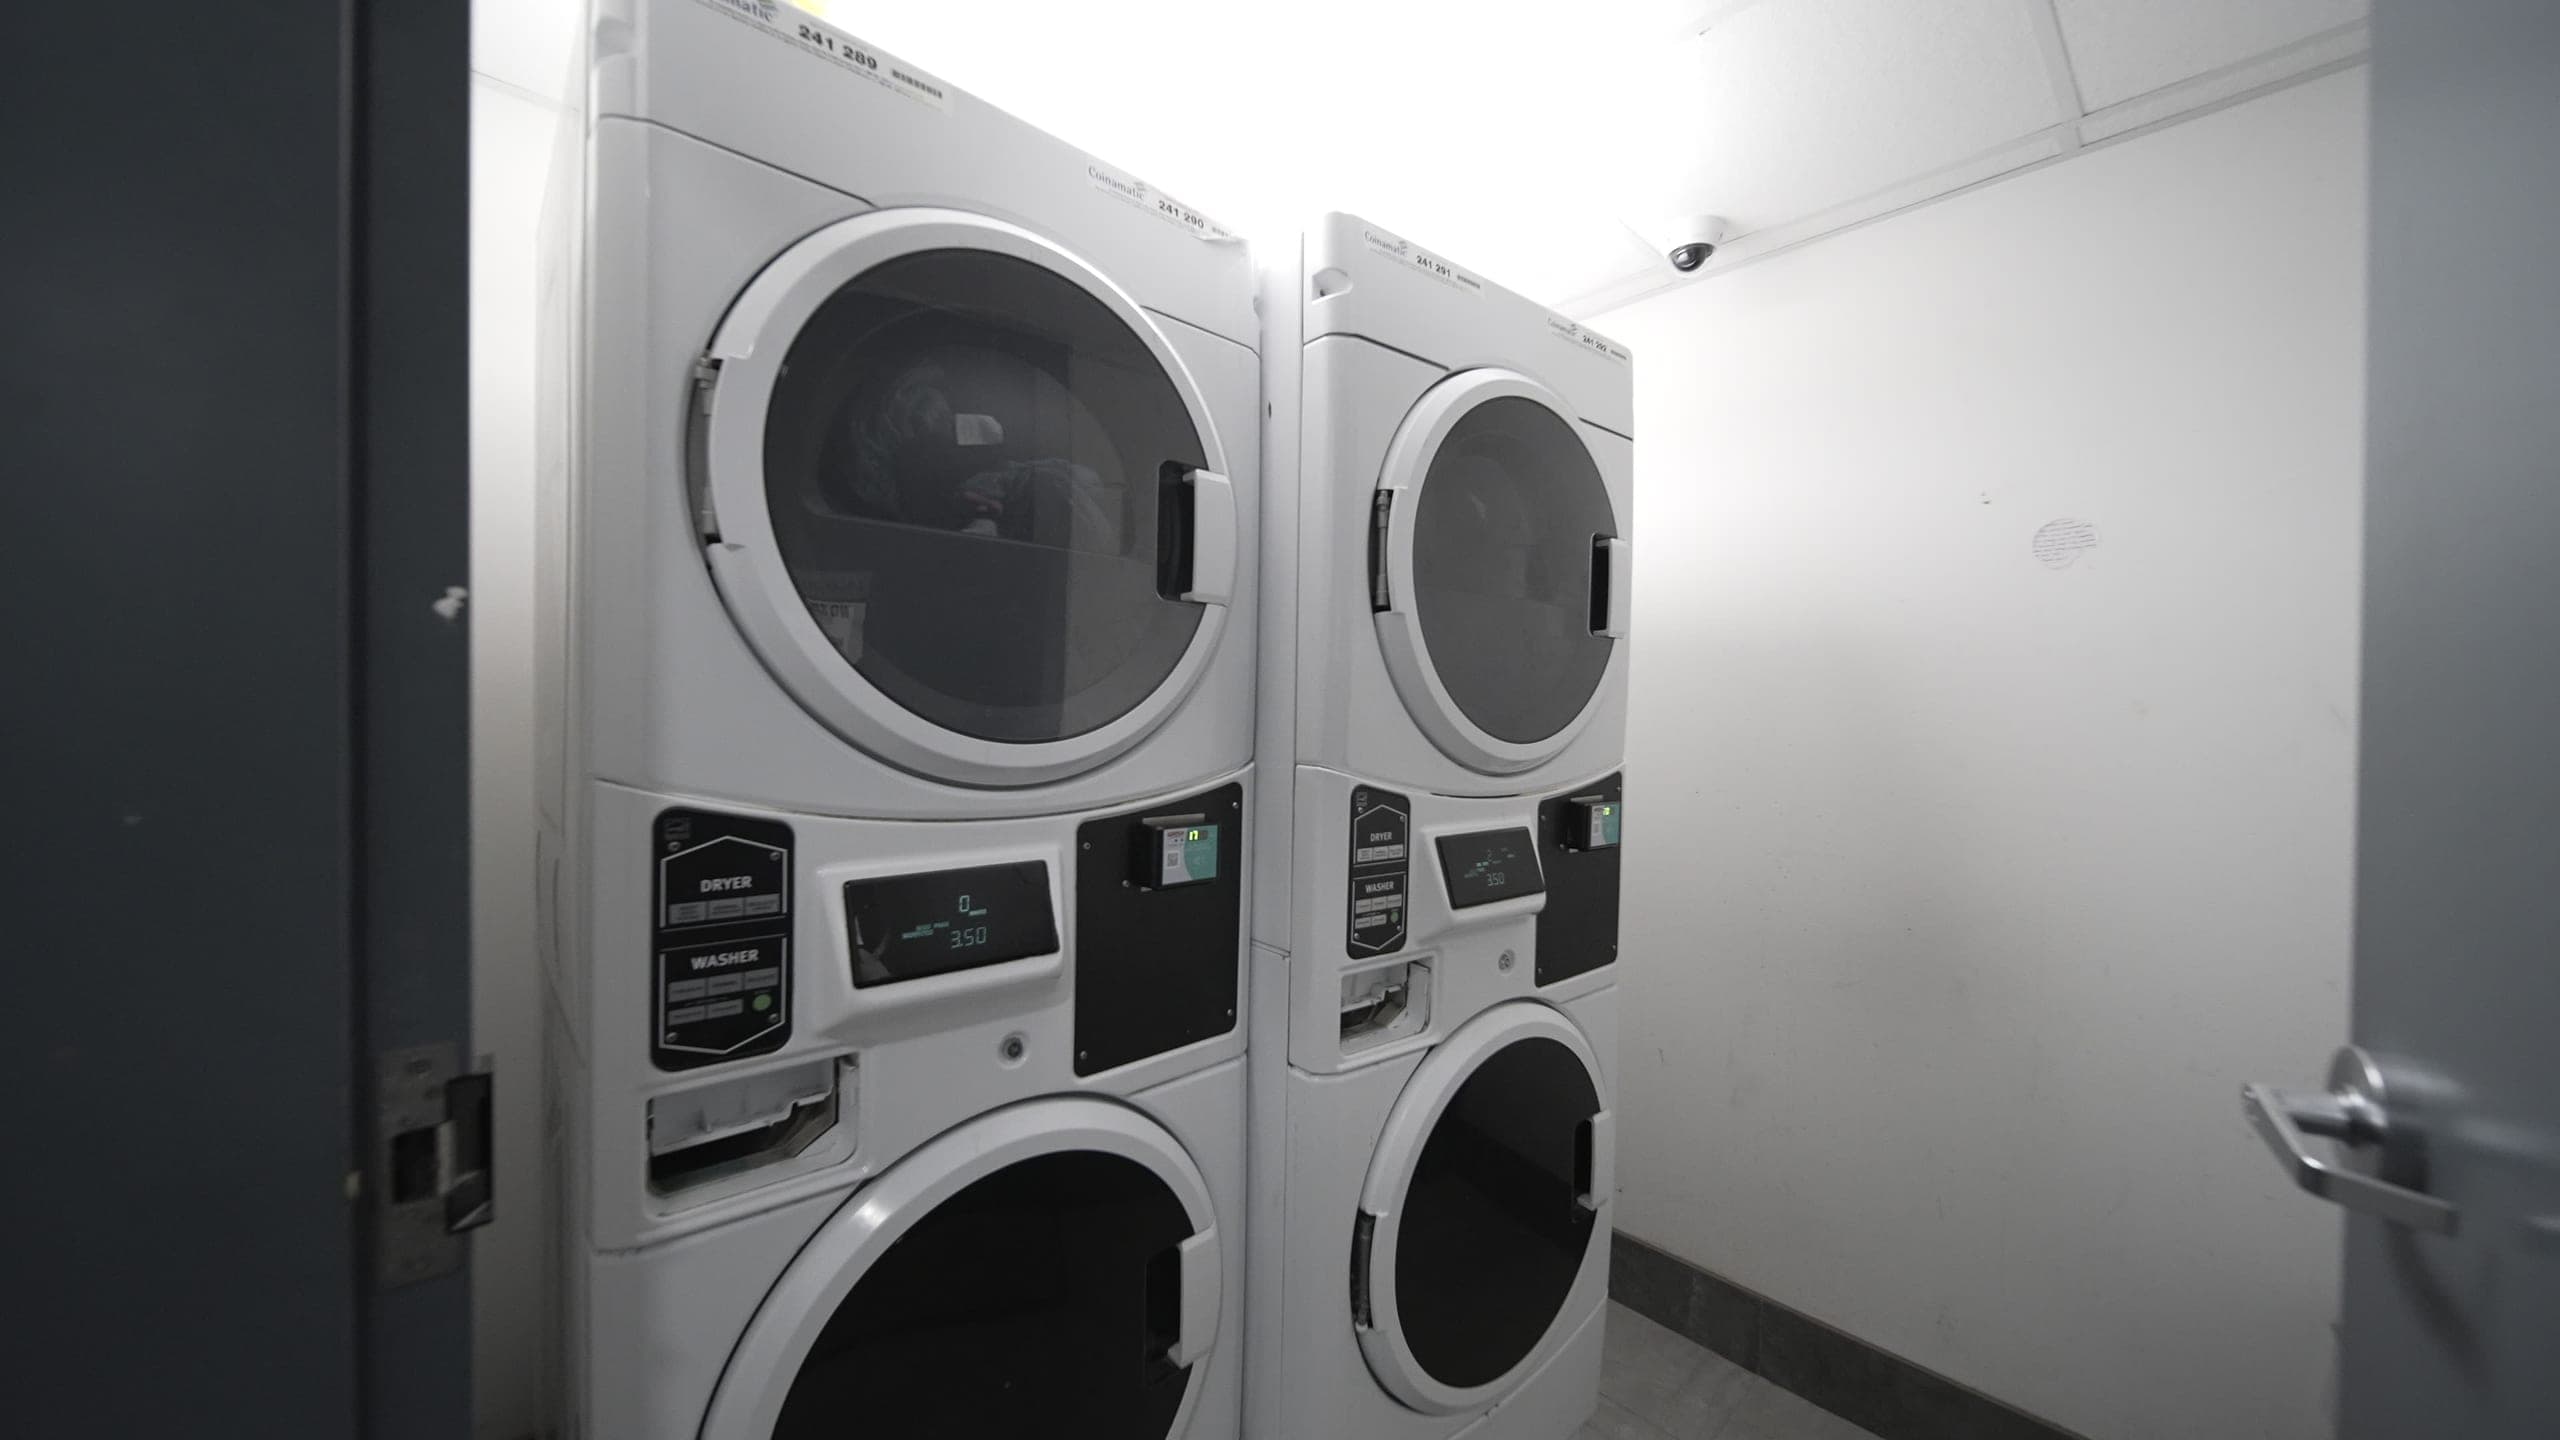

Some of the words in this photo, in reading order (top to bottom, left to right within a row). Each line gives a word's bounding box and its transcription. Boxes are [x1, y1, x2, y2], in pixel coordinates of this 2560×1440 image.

[798, 24, 834, 51] 241
[843, 44, 878, 70] 289
[1088, 165, 1145, 200] Coinamatic
[1158, 200, 1179, 217] 241
[1184, 212, 1204, 229] 290
[1416, 255, 1432, 269] 241
[1370, 832, 1393, 842] DRYER
[700, 875, 753, 893] DRYER
[1365, 881, 1394, 893] WASHER
[691, 949, 760, 970] WASHER
